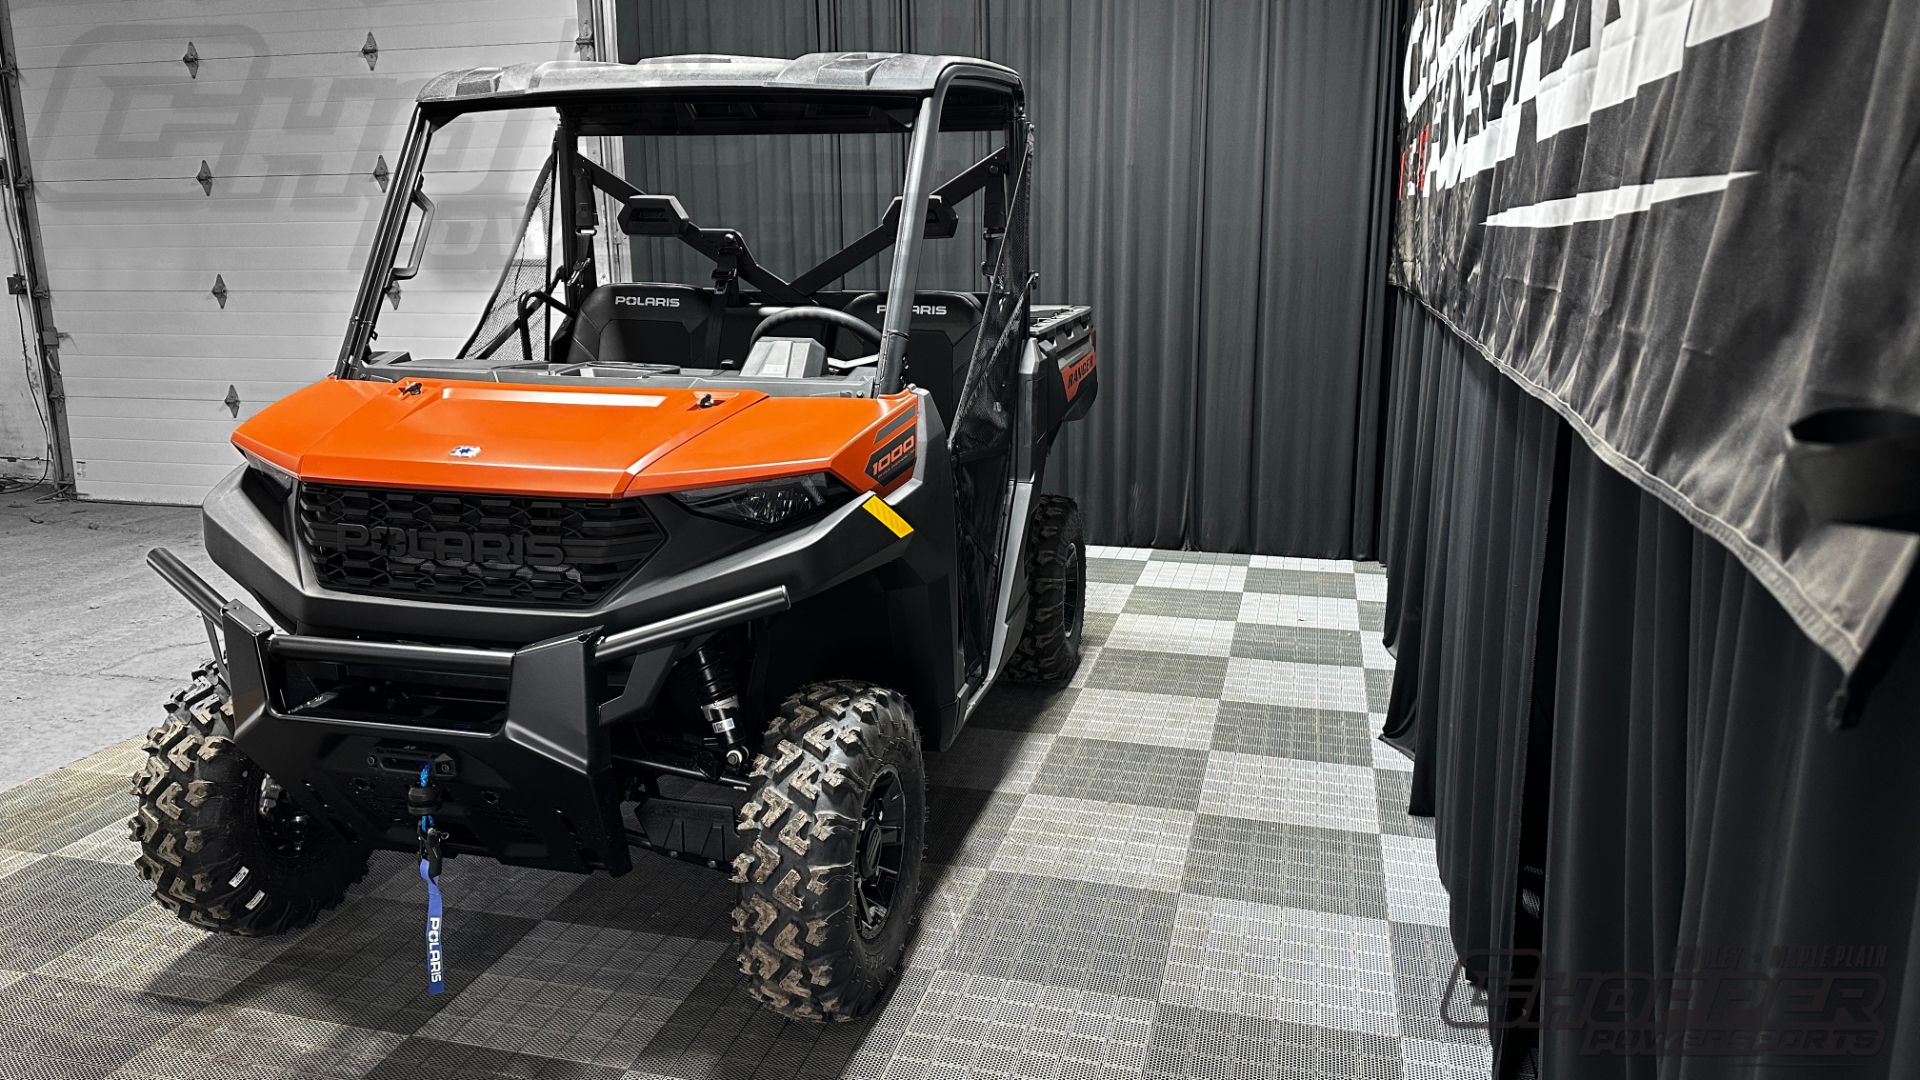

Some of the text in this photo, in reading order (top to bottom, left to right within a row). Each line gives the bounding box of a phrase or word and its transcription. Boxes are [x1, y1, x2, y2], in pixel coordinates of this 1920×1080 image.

[615, 295, 680, 308] POLARIS
[876, 304, 948, 316] PARIS
[1067, 353, 1095, 390] RANGER
[872, 435, 915, 476] 1000
[336, 522, 565, 567] POLARIS
[428, 916, 442, 983] POLARIS
